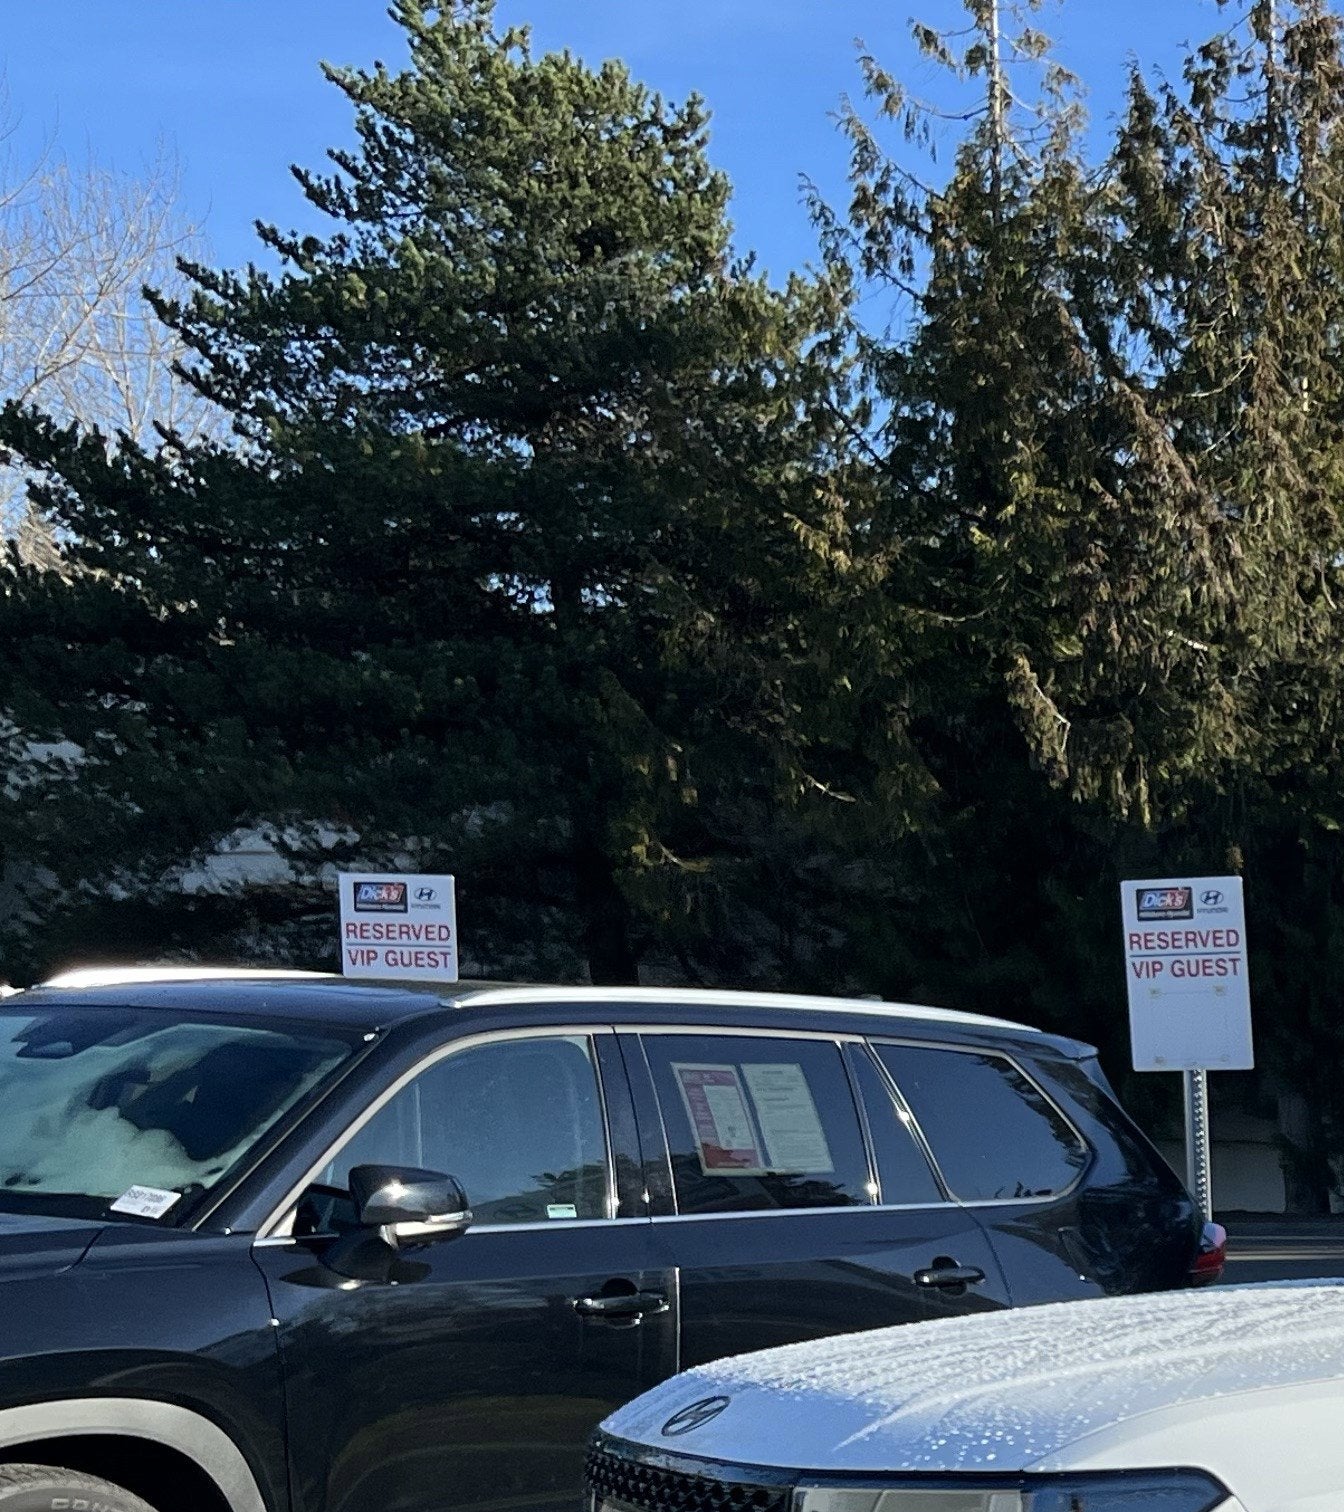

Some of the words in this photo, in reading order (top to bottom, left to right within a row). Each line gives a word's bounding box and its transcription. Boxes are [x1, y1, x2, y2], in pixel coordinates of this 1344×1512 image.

[345, 922, 450, 941] RESERVED
[1129, 929, 1240, 951] RESERVED
[349, 950, 378, 966] VIP
[385, 950, 451, 968] GUEST
[1132, 960, 1163, 978] VIP
[1170, 958, 1241, 977] GUEST
